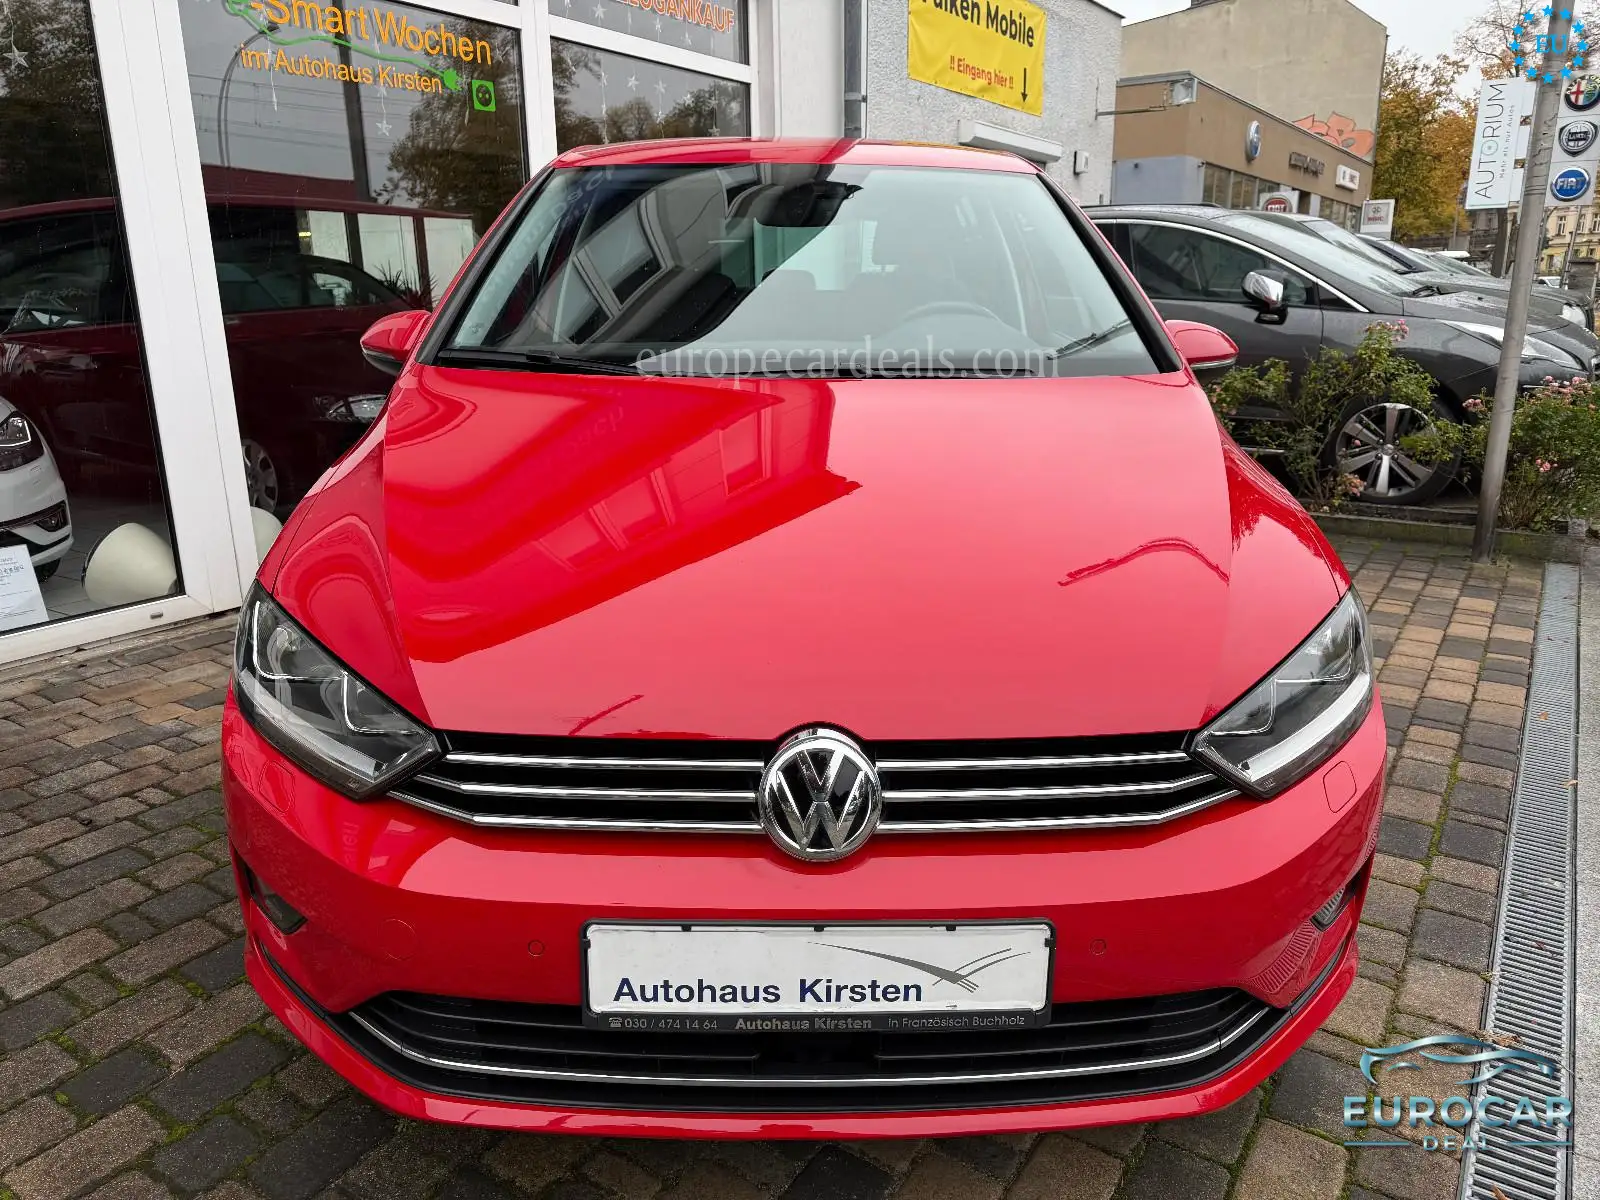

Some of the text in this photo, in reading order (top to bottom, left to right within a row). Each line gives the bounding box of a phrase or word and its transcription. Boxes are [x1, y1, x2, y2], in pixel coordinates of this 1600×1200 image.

[373, 8, 492, 65] Wochen
[986, 1, 1034, 47] Mobile
[240, 43, 442, 93] im Autohaus Kirsten
[957, 58, 992, 86] Eingang
[993, 68, 1008, 87] hier
[1475, 82, 1508, 200] AUTORIUM
[1556, 177, 1585, 191] FIAT
[613, 977, 922, 1003] Autohaus Kirsten
[625, 1018, 647, 1029] 030
[658, 1018, 681, 1029] 474
[685, 1018, 699, 1029] 14
[703, 1018, 718, 1029] 64
[734, 1017, 810, 1031] Autohaus
[814, 1016, 872, 1030] Kirsten
[902, 1015, 969, 1028] Französisch
[972, 1014, 1025, 1027] Buchholz
